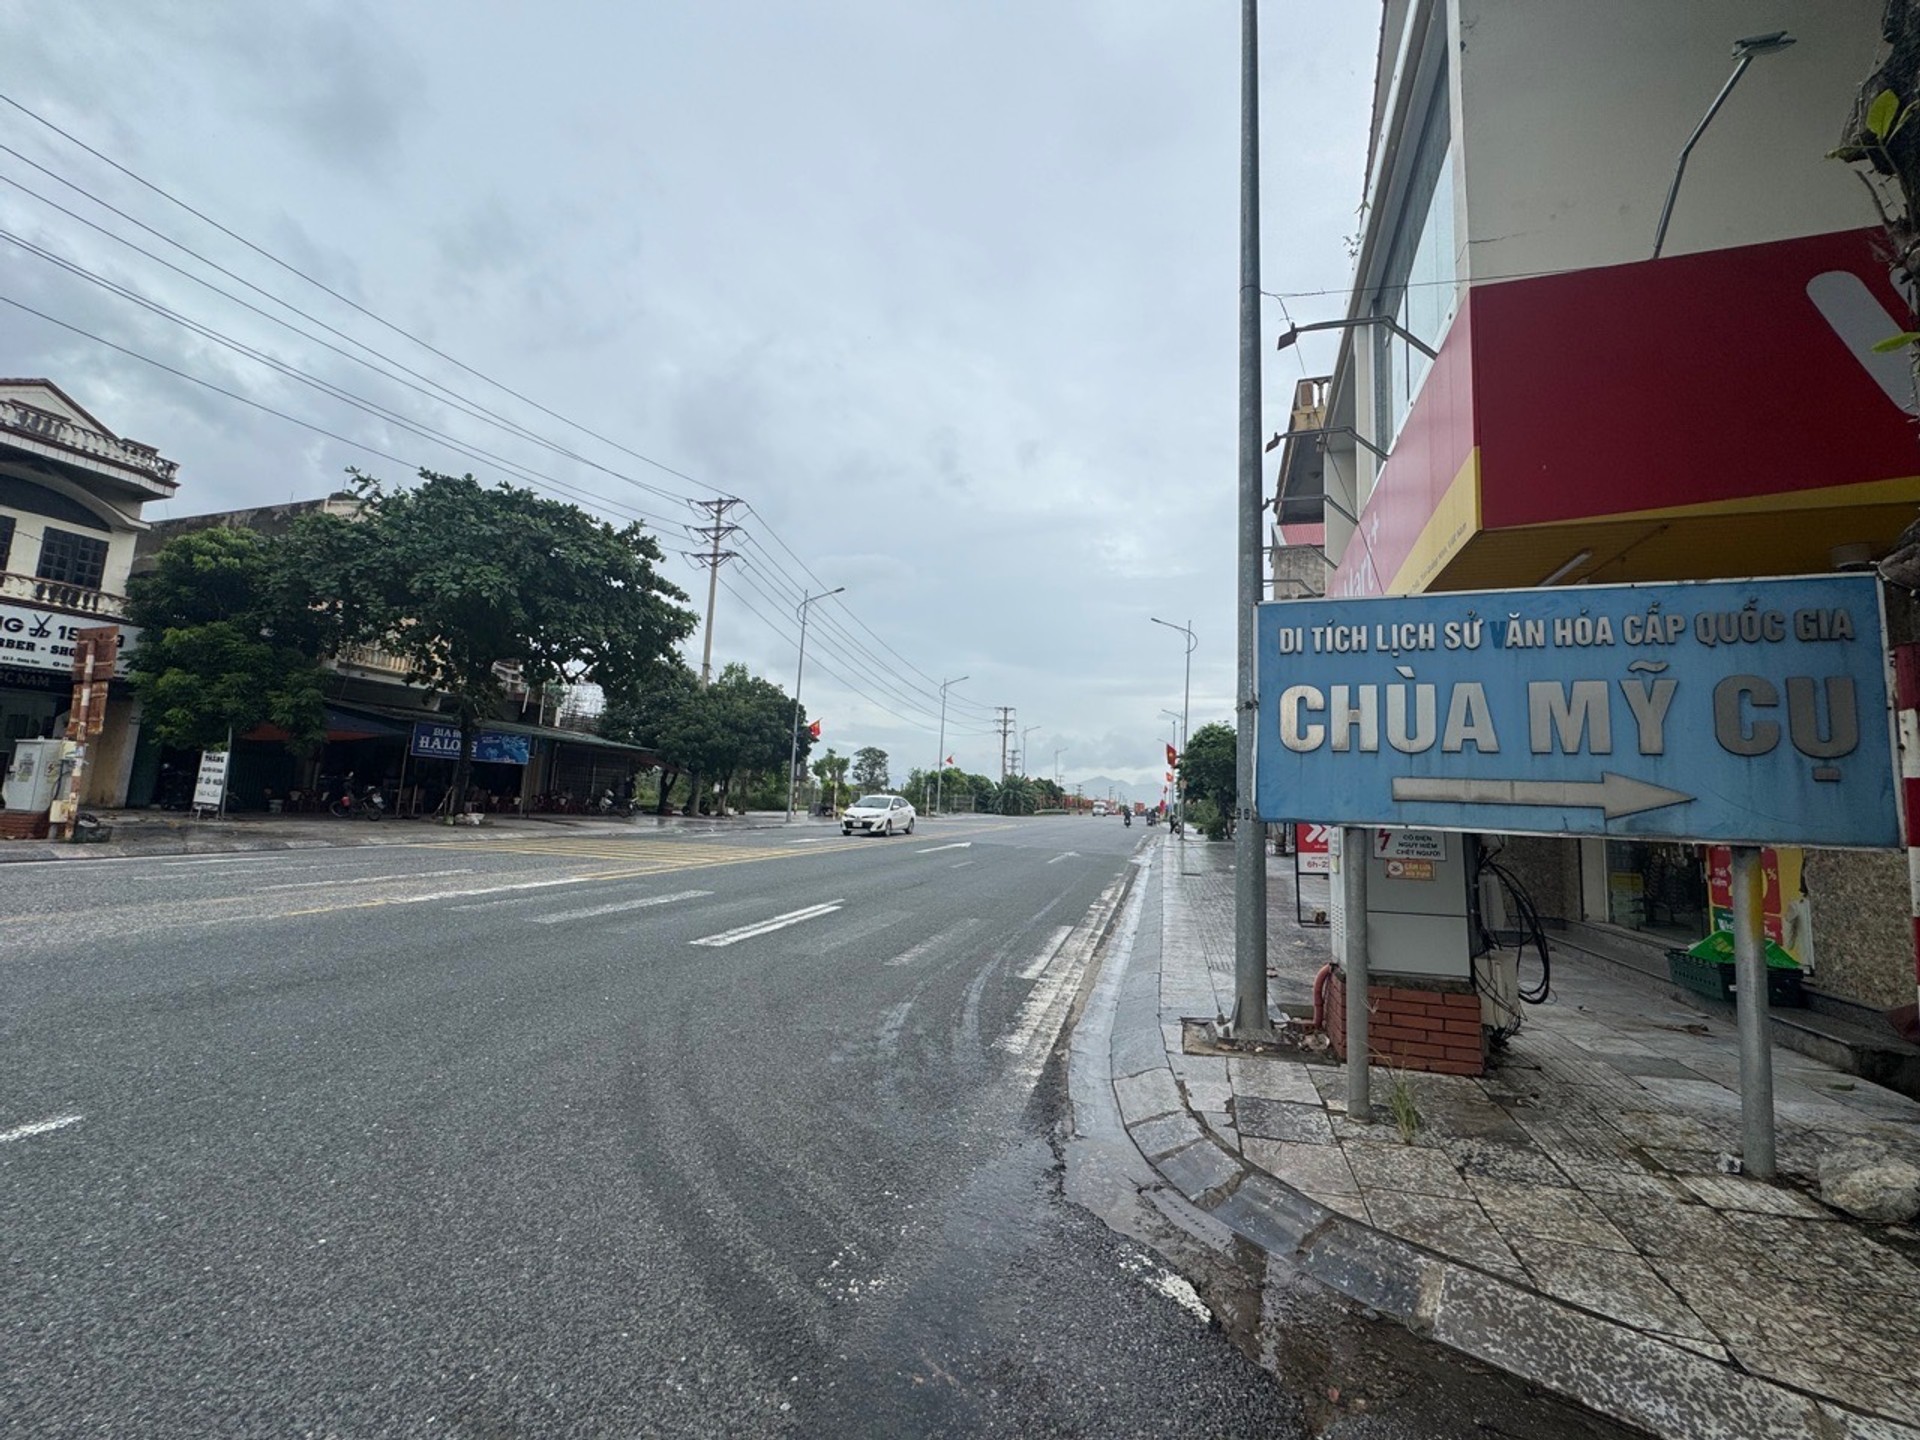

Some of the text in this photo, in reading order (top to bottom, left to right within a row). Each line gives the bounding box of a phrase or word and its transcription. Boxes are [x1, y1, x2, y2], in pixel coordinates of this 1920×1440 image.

[1280, 627, 1304, 654] DI
[1311, 618, 1368, 653] TÍCH
[1376, 622, 1436, 657] LỊCH
[1444, 609, 1484, 649] SỬ
[1553, 608, 1615, 647] HÓA
[1622, 602, 1686, 646] CẤP
[1694, 600, 1786, 647] QUỐC
[1793, 608, 1856, 642] GIA
[1279, 658, 1860, 783] CHÙA MỸ CỤ
